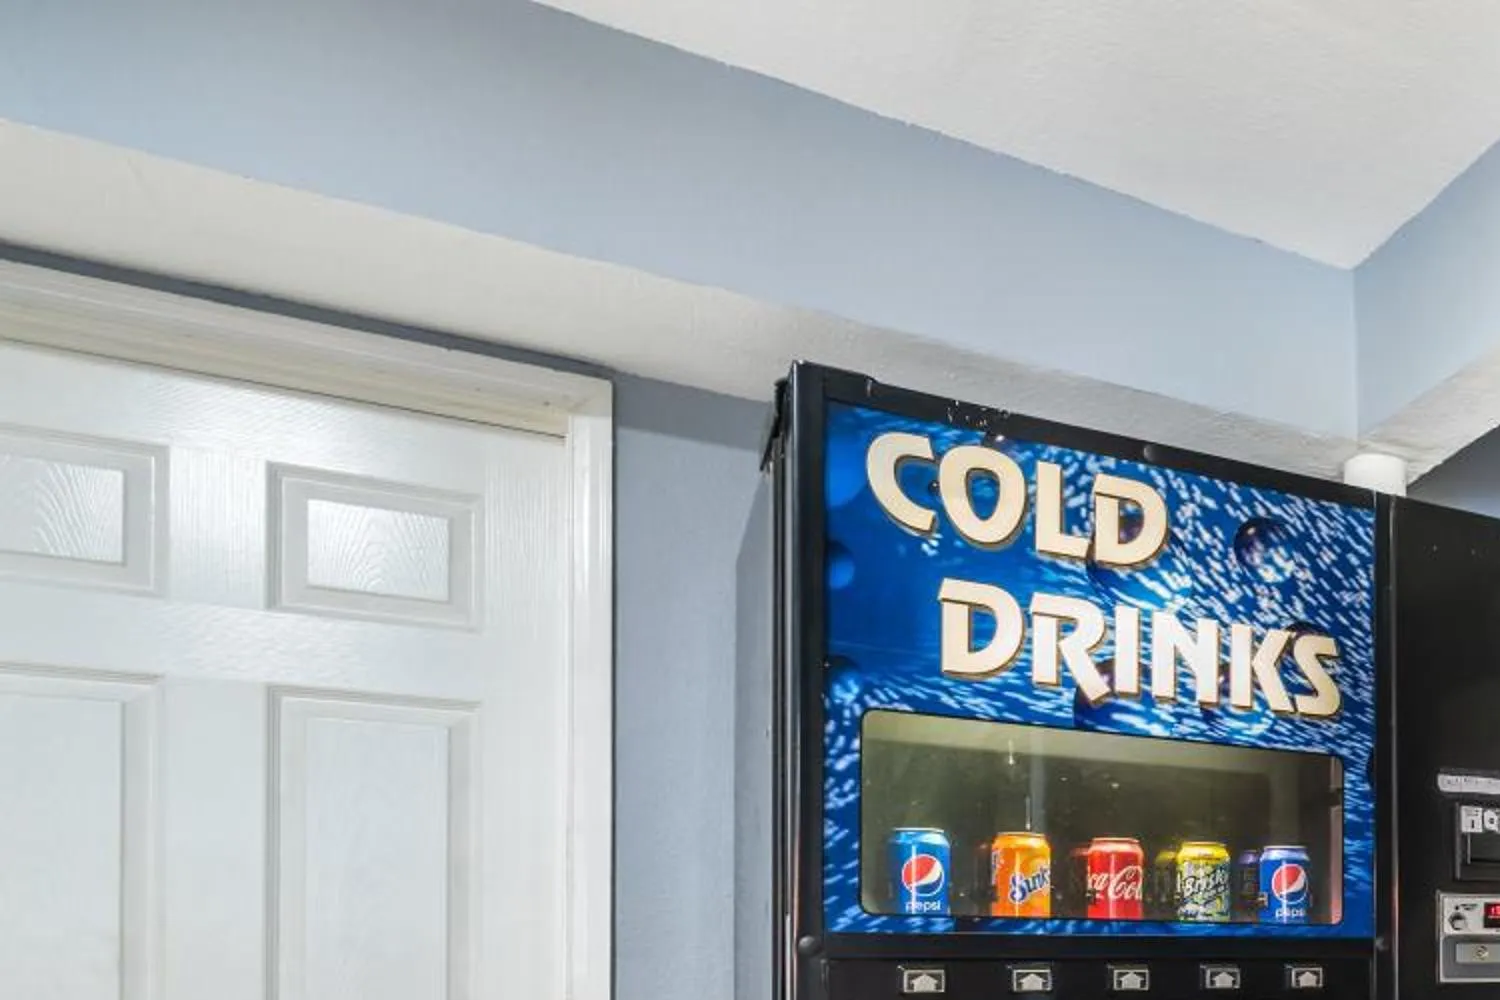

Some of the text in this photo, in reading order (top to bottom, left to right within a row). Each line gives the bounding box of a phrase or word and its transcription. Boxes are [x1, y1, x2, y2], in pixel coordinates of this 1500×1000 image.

[866, 431, 1170, 567] COLD
[937, 577, 1342, 718] DRINKS
[905, 900, 942, 913] pepsi
